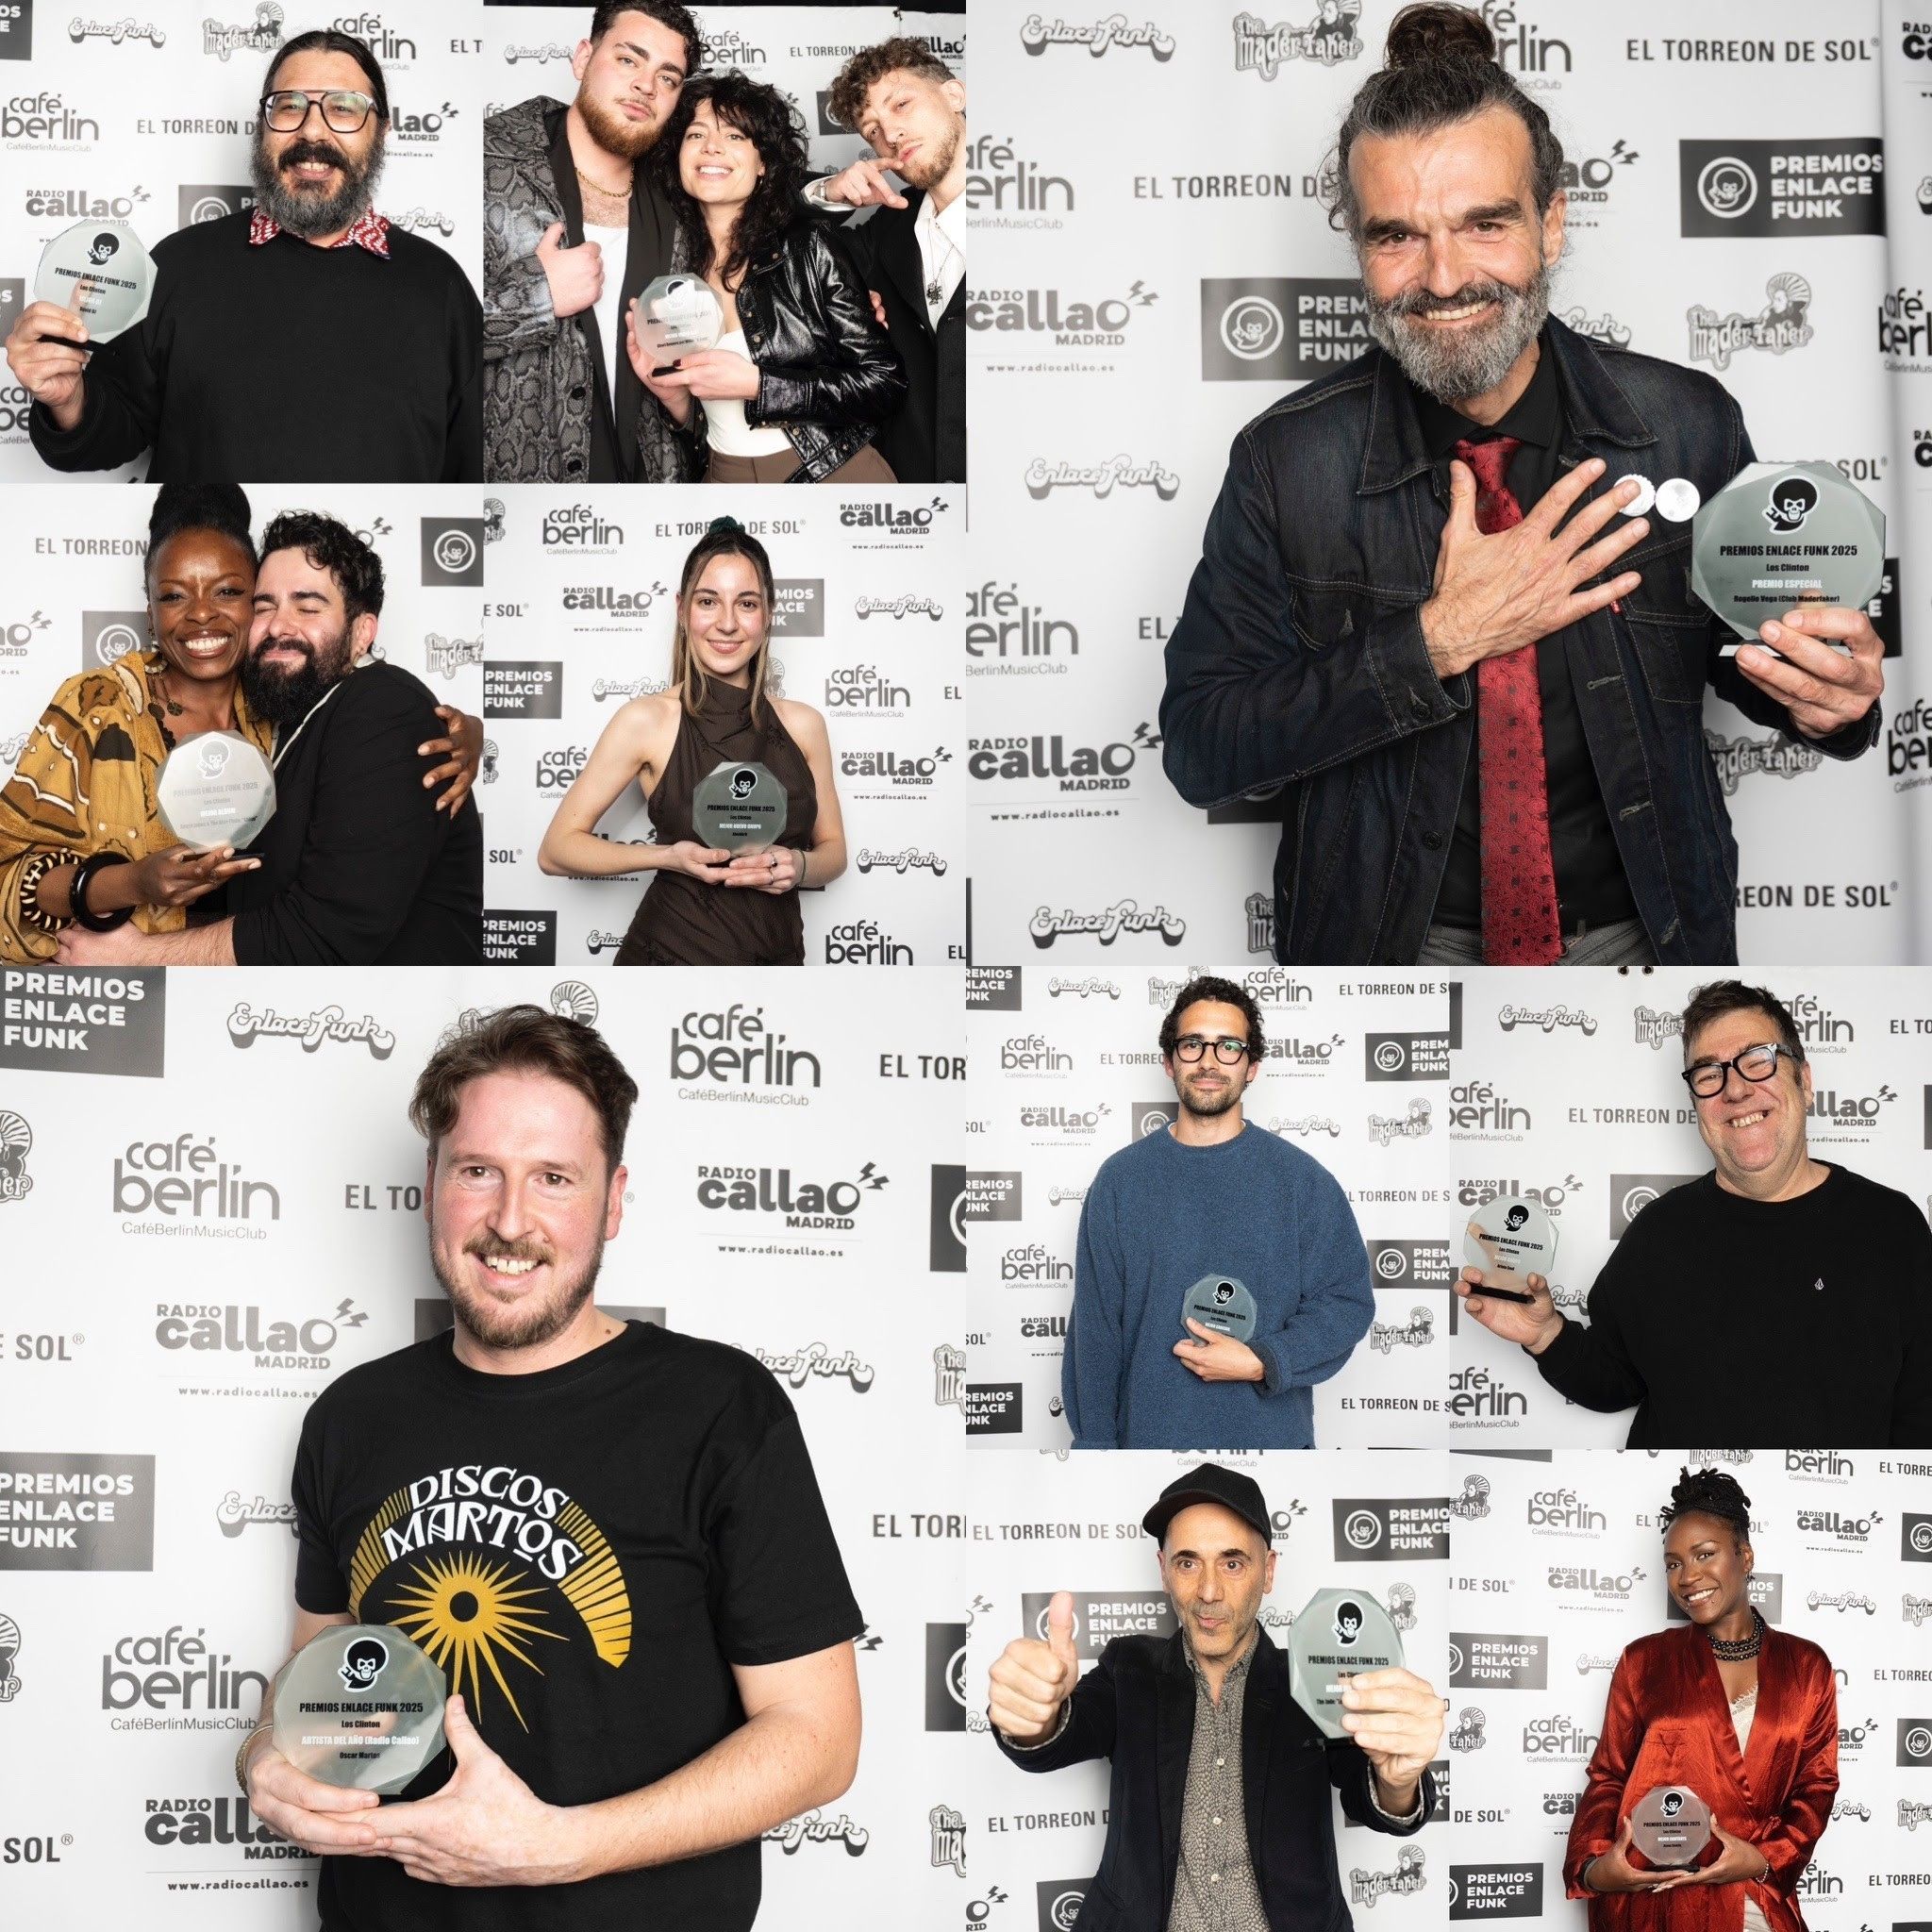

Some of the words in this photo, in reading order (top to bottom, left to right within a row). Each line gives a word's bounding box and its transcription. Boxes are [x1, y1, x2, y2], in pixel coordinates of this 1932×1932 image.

[333, 12, 380, 35] café
[808, 45, 857, 57] TORREON
[1626, 41, 1654, 60] EL
[1663, 40, 1774, 61] TORREON
[1786, 41, 1815, 61] DE
[9, 92, 61, 114] café
[161, 120, 239, 135] TORREON
[1771, 155, 1883, 174] PREMIOS
[1135, 176, 1163, 198] EL
[1173, 175, 1291, 197] TORREON
[1772, 177, 1872, 195] ENLACE
[26, 190, 65, 199] RADIO
[1773, 200, 1842, 219] FUNK
[55, 267, 81, 278] PREMIOS
[82, 273, 104, 283] ENLACE
[104, 276, 121, 287] FUNK
[121, 280, 137, 289] 2025
[966, 291, 1024, 301] RADIO
[1056, 335, 1124, 345] MADRID
[549, 504, 592, 524] café
[35, 539, 57, 555] EL
[1720, 545, 1764, 556] PREMIOS
[1766, 545, 1802, 556] ENLACE
[1804, 545, 1829, 556] FUNK
[1832, 545, 1857, 556] 2025
[1752, 579, 1783, 589] PREMIO
[1785, 579, 1823, 589] ESPECIAL
[1139, 618, 1168, 640] EL
[485, 671, 553, 683] PREMIOS
[831, 664, 876, 684] café
[485, 684, 543, 695] ENLACE
[485, 697, 525, 708] FUNK
[968, 739, 1027, 750] RADIO
[242, 782, 258, 791] 2025
[1059, 777, 1130, 791] MADRID
[991, 808, 1120, 821] www.radiocallao.es
[1805, 886, 1836, 906] DE
[831, 920, 878, 941] café
[5, 972, 144, 1001] PREMIOS
[1357, 983, 1415, 995] TORREON
[5, 998, 125, 1026] ENLACE
[682, 1004, 764, 1041] café
[5, 1024, 89, 1051] FUNK
[1007, 1034, 1044, 1052] café
[879, 1055, 908, 1077] EL
[1412, 1061, 1449, 1073] FUNK
[1569, 1108, 1588, 1123] EL
[1593, 1108, 1670, 1124] TORREON
[1833, 1118, 1876, 1126] MADRID
[125, 1133, 216, 1173] café
[698, 1167, 756, 1180] RADIO
[345, 1185, 376, 1209] EL
[1358, 1191, 1417, 1202] TORREON
[786, 1216, 855, 1230] MADRID
[1479, 1234, 1500, 1242] PREMIOS
[718, 1244, 843, 1257] www.radiocallao.es
[1007, 1244, 1045, 1262] café
[157, 1305, 222, 1319] RADIO
[255, 1356, 330, 1370] MADRID
[178, 1386, 318, 1398] www.radiocallao.es
[1360, 1398, 1418, 1410] TORREON
[0, 1474, 134, 1496] PREMIOS
[409, 1465, 570, 1520] DISCOS
[1534, 1489, 1576, 1507] café
[0, 1501, 115, 1522] ENLACE
[873, 1515, 902, 1538] EL
[974, 1524, 994, 1541] EL
[1001, 1524, 1081, 1540] TORREON
[1089, 1524, 1109, 1540] DE
[0, 1527, 77, 1549] FUNK
[380, 1501, 584, 1580] MARTOS
[1391, 1537, 1434, 1549] FUNK
[1088, 1603, 1167, 1615] PREMIOS
[1090, 1617, 1158, 1630] ENLACE
[115, 1625, 206, 1665] café
[1472, 1643, 1539, 1656] PREMIOS
[1308, 1656, 1335, 1664] PREMIOS
[1472, 1657, 1529, 1668] ENLACE
[1472, 1668, 1512, 1679] FUNK
[300, 1703, 339, 1712] PREMIOS
[341, 1703, 373, 1712] ENLACE
[375, 1703, 398, 1712] FUNK
[400, 1703, 423, 1712] 2025
[1529, 1715, 1572, 1734] café
[302, 1736, 332, 1745] ARTISTA
[334, 1736, 347, 1744] DEL
[348, 1735, 364, 1745] AÑO
[145, 1799, 211, 1812] RADIO
[1015, 1811, 1095, 1831] TORREON
[167, 1878, 309, 1890] www.radiocallao.es
[1467, 1873, 1533, 1885] PREMIOS
[1467, 1885, 1524, 1896] ENLACE
[1467, 1897, 1507, 1909] FUNK
